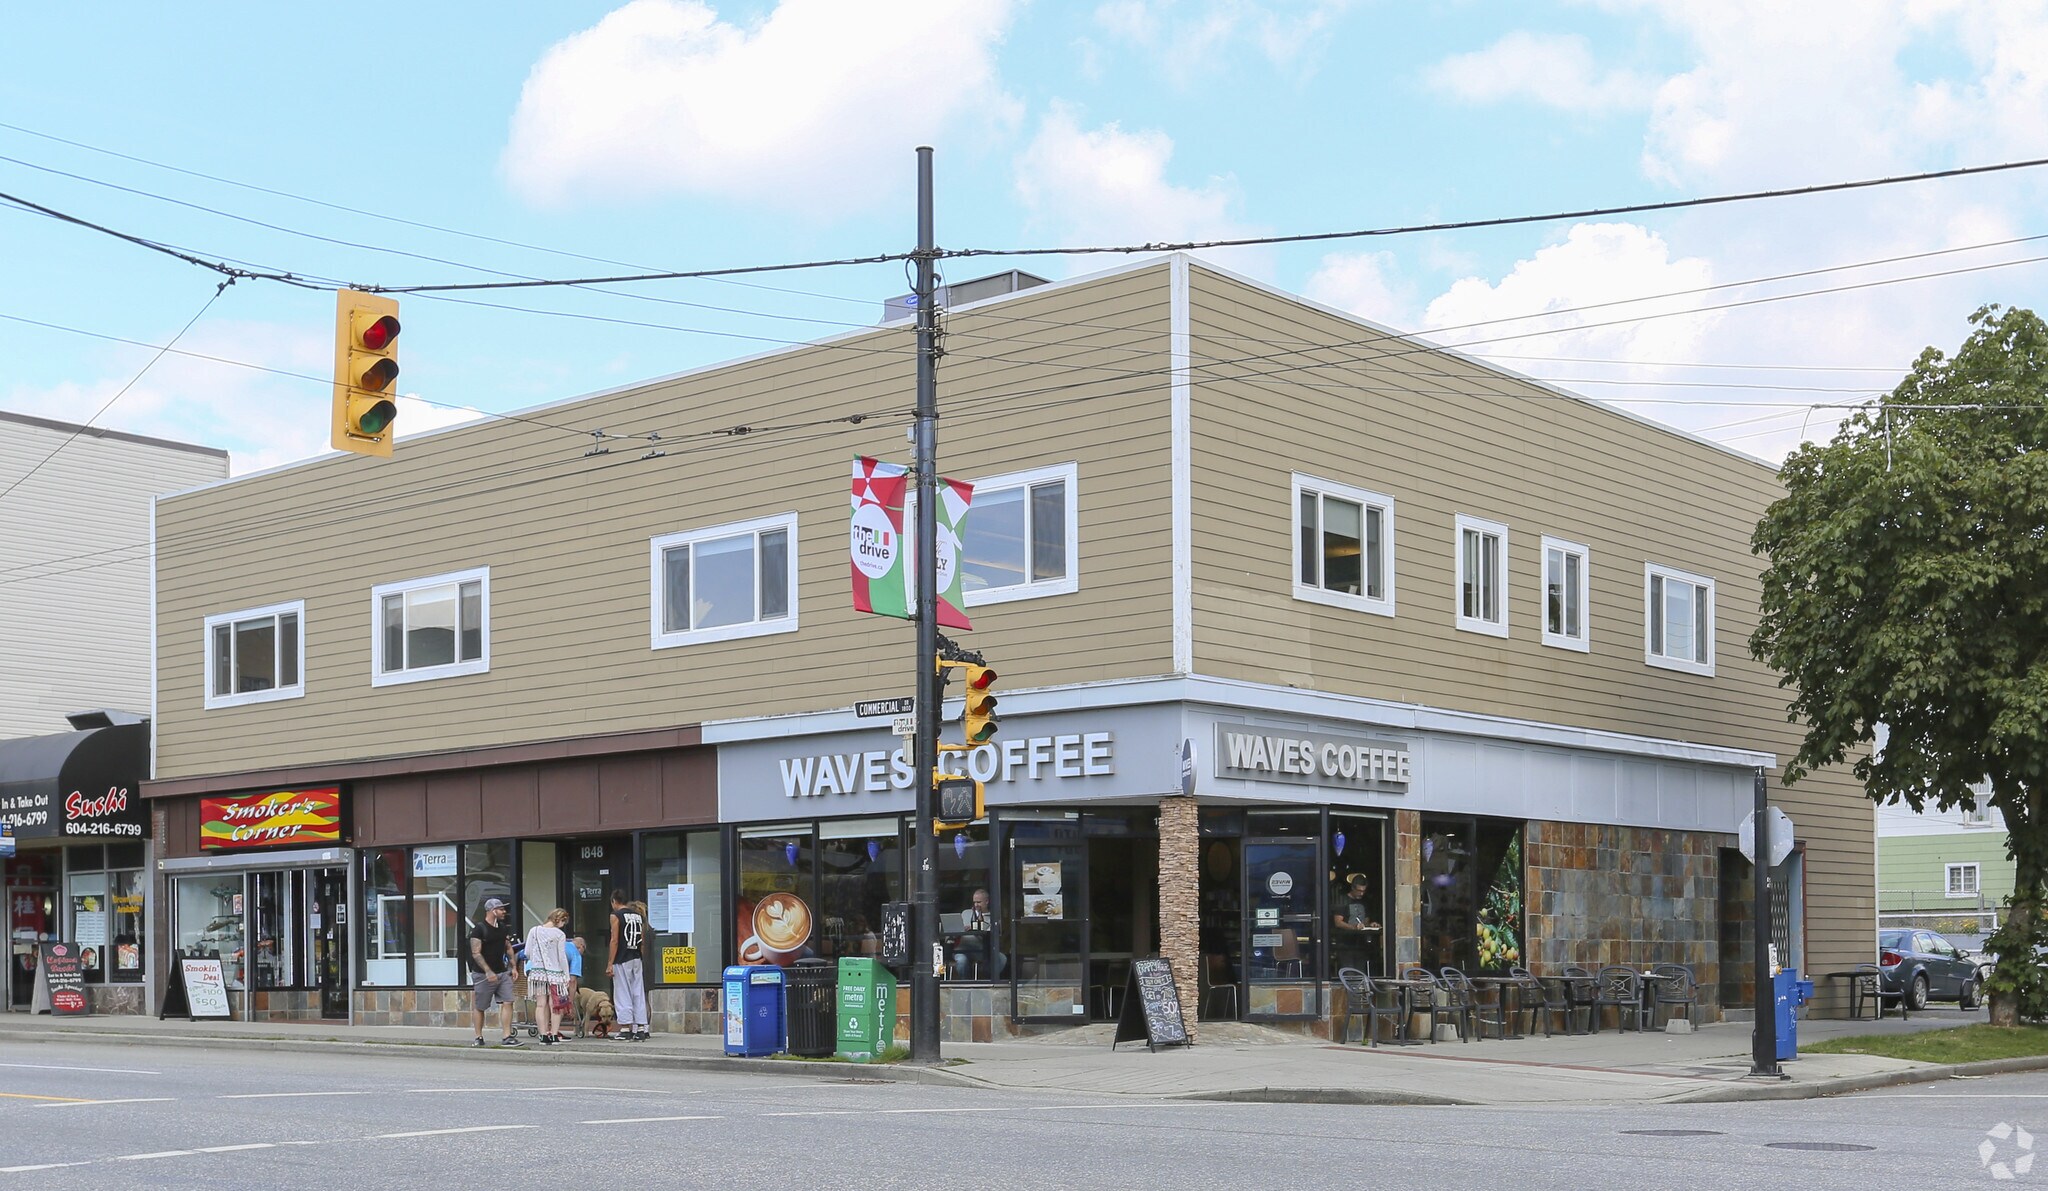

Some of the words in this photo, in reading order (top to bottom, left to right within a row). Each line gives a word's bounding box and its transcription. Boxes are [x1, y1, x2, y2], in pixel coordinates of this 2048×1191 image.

[860, 540, 890, 559] drive
[860, 701, 900, 715] COMMERCIAL
[779, 748, 916, 798] WAVES
[937, 731, 1115, 784] COFFEE
[1226, 732, 1316, 775] WAVES
[1320, 742, 1412, 784] COFFEE
[17, 796, 33, 808] Take
[34, 794, 49, 807] Out
[65, 786, 128, 820] Sushi
[222, 797, 316, 821] Smoker's
[0, 811, 48, 828] 4-216-6799
[65, 822, 142, 836] 604-216-6799
[230, 824, 302, 842] Corner
[423, 854, 447, 865] Terra
[581, 846, 604, 859] 1848
[586, 887, 602, 896] Terra
[663, 948, 675, 956] FOR
[675, 947, 695, 955] LEASE
[664, 956, 692, 964] CONTACT
[185, 964, 220, 972] Smokin'
[845, 994, 864, 1002] metro
[876, 986, 888, 1053] metro
